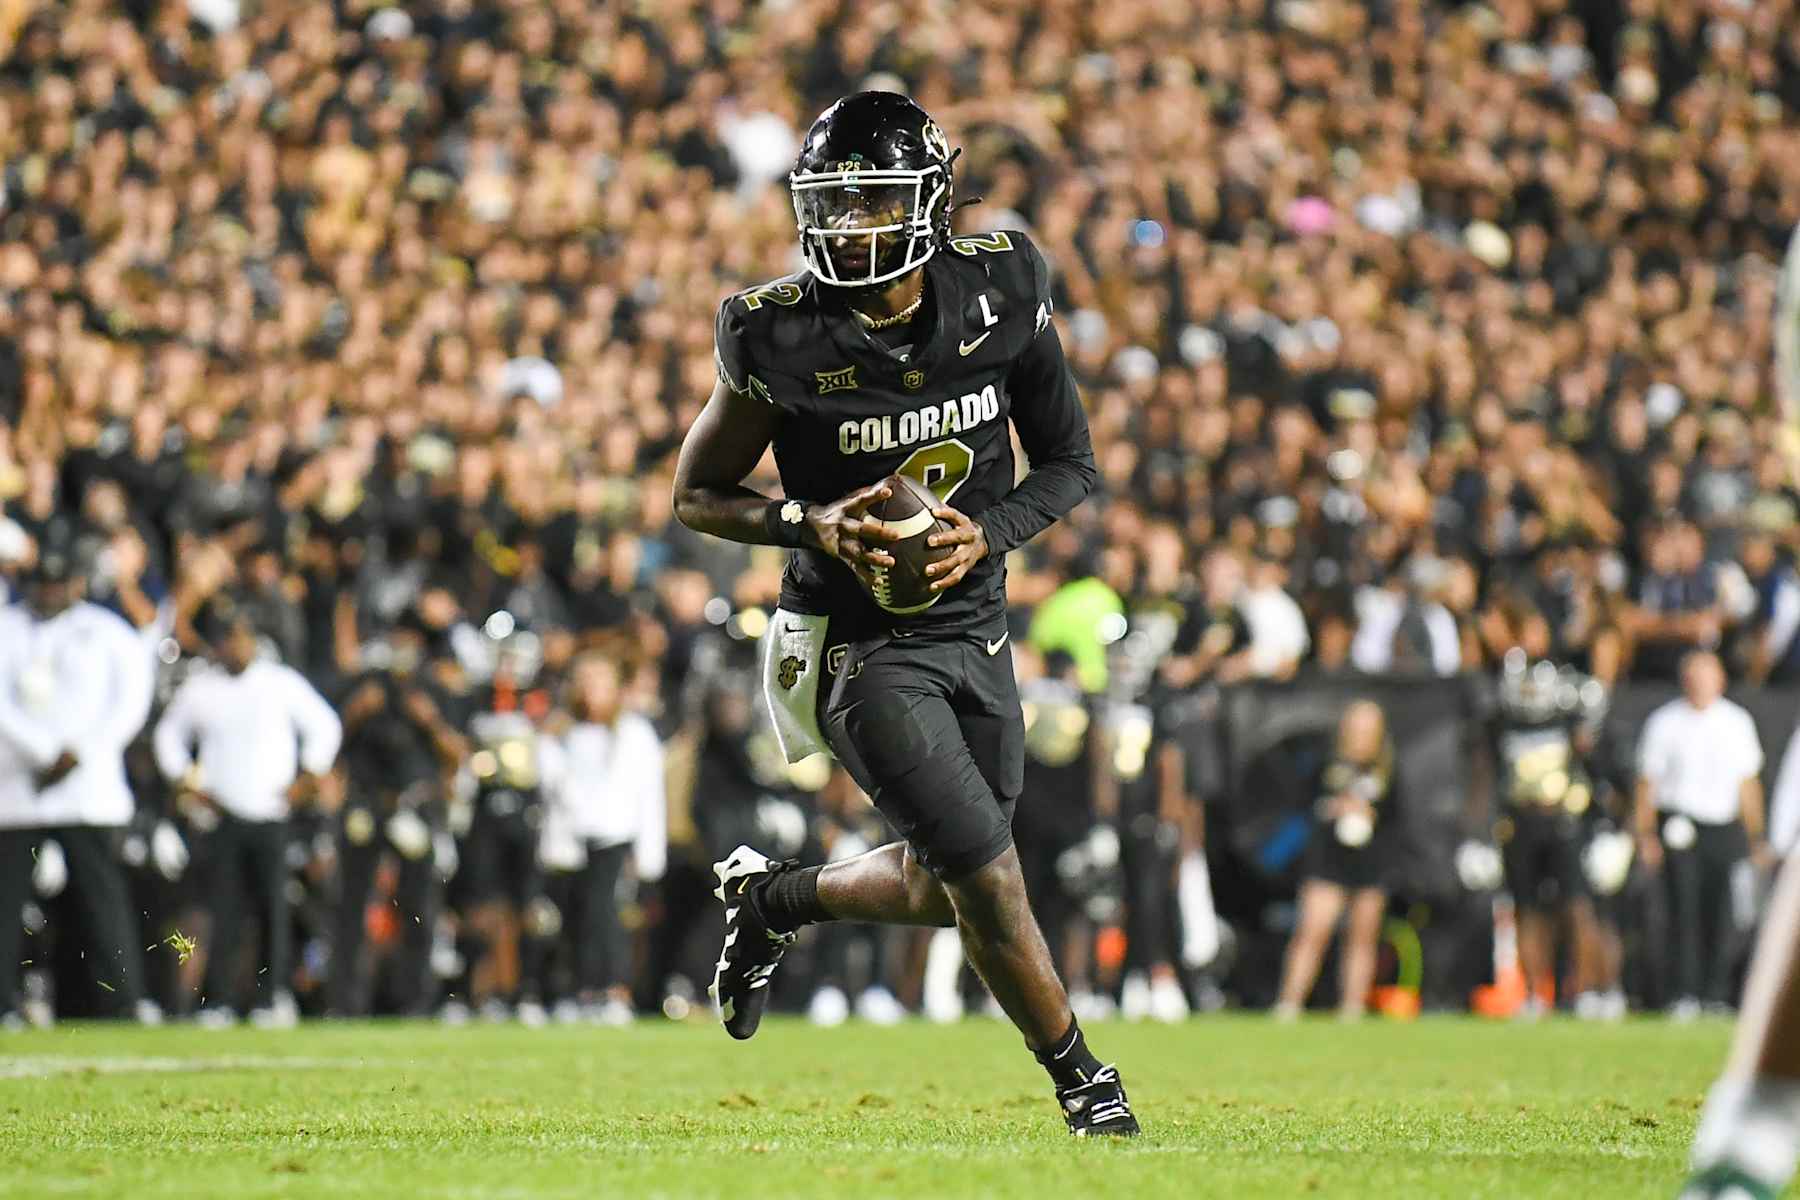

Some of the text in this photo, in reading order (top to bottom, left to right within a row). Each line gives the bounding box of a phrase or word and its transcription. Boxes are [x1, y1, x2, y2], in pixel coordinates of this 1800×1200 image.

[950, 231, 1014, 256] 2
[742, 283, 804, 311] 2
[978, 294, 999, 328] L
[838, 384, 999, 454] COLORADO
